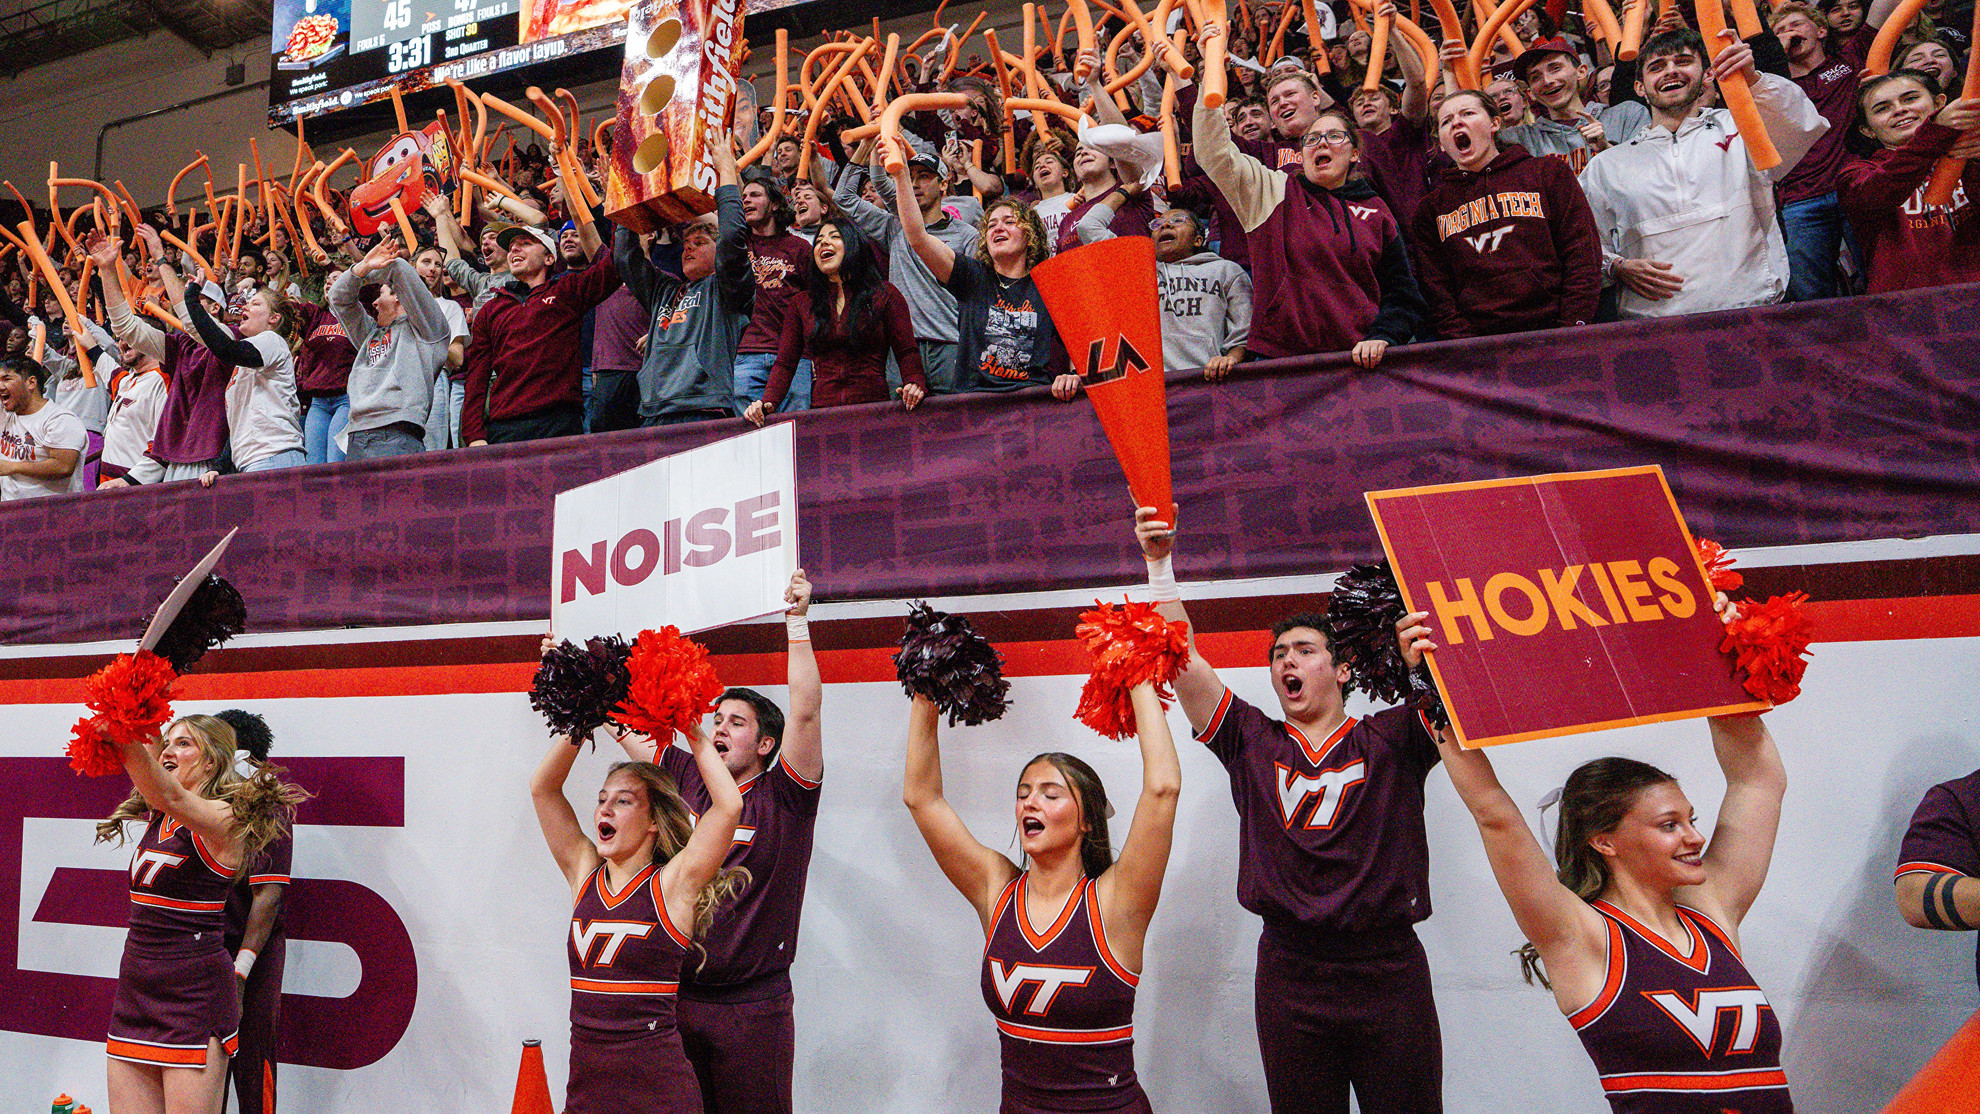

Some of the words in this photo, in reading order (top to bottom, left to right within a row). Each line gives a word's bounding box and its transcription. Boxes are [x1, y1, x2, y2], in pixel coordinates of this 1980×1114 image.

[384, 0, 411, 31] 45
[422, 20, 441, 35] POSS
[445, 26, 465, 41] SHOT
[466, 22, 478, 37] 30
[448, 11, 474, 28] BONUS
[477, 5, 500, 21] FOULS
[357, 37, 379, 52] FOULS
[388, 34, 431, 73] 3:31
[434, 64, 463, 83] We're
[489, 56, 496, 69] a
[499, 45, 531, 68] flavor
[694, 0, 736, 196] Sithfiel
[1349, 205, 1378, 220] VT
[1436, 195, 1499, 242] VIRGINIA
[1497, 192, 1546, 219] TECH
[1464, 224, 1516, 254] VT
[542, 296, 556, 304] VT
[979, 355, 1029, 380] Home
[561, 490, 781, 604] NOISE
[1425, 556, 1697, 645] HOKIES
[1274, 757, 1367, 830] VT
[129, 846, 189, 888] VT
[571, 918, 657, 969] VT
[988, 956, 1097, 1017] VT
[1639, 986, 1771, 1060] VT
